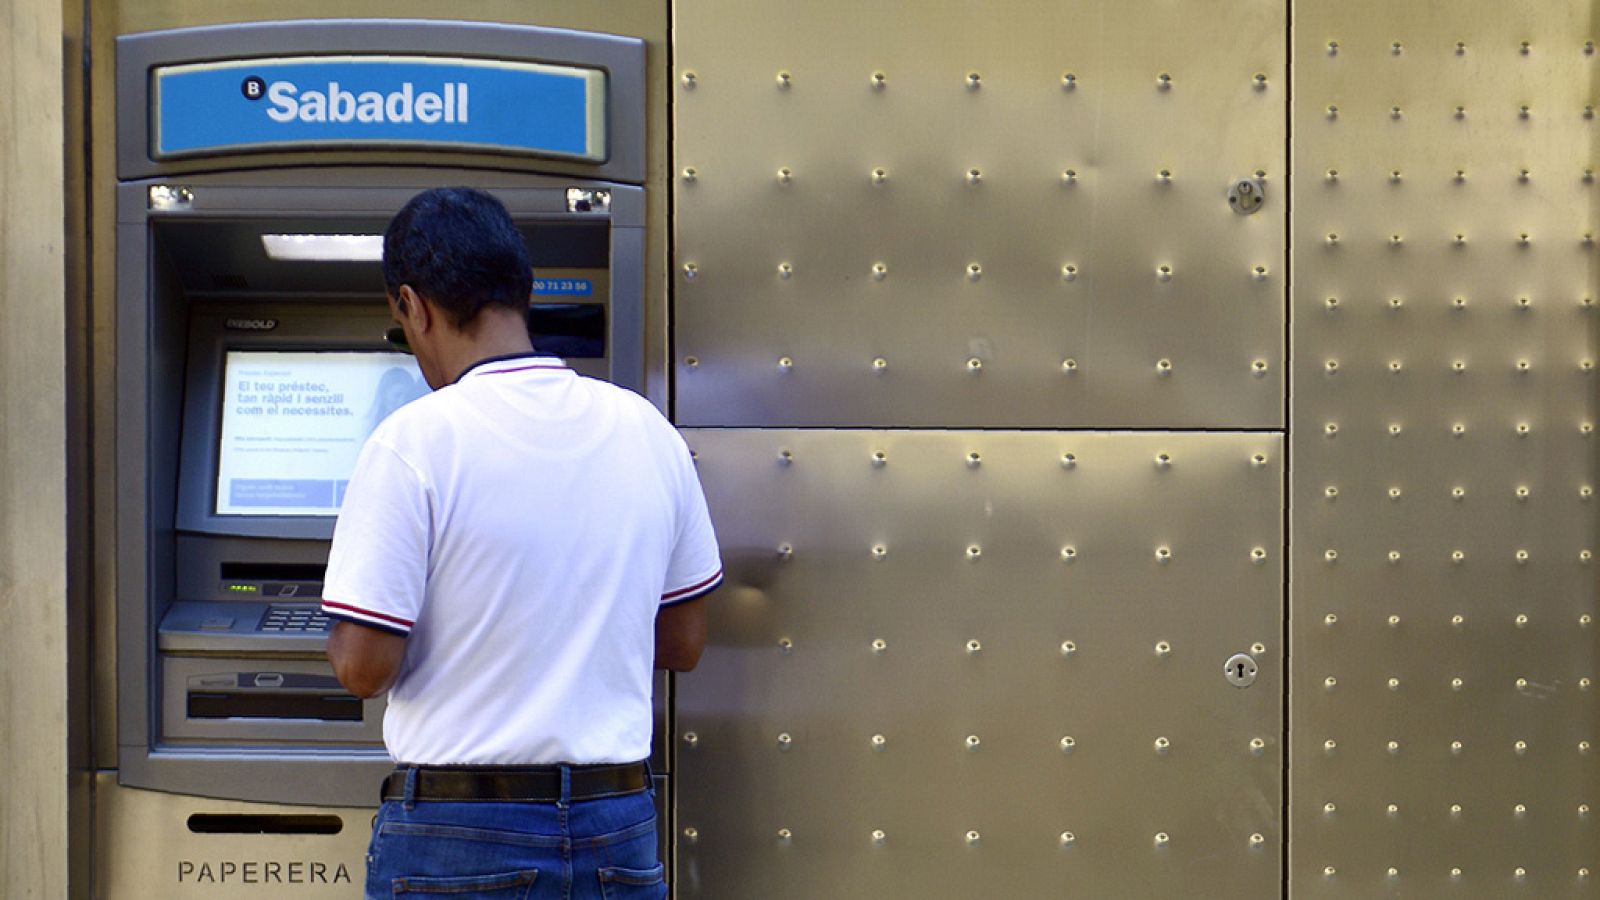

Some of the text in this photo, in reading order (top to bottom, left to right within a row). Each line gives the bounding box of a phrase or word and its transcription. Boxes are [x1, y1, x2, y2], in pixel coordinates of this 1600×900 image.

[266, 81, 468, 123] Sabadell
[547, 281, 558, 290] 71
[238, 381, 250, 391] El
[254, 381, 274, 391] teu
[238, 393, 257, 403] tan
[262, 392, 292, 405] ràpid
[305, 393, 344, 403] senzill
[236, 404, 354, 415] com el necessites.
[177, 861, 352, 883] PAPERERA
